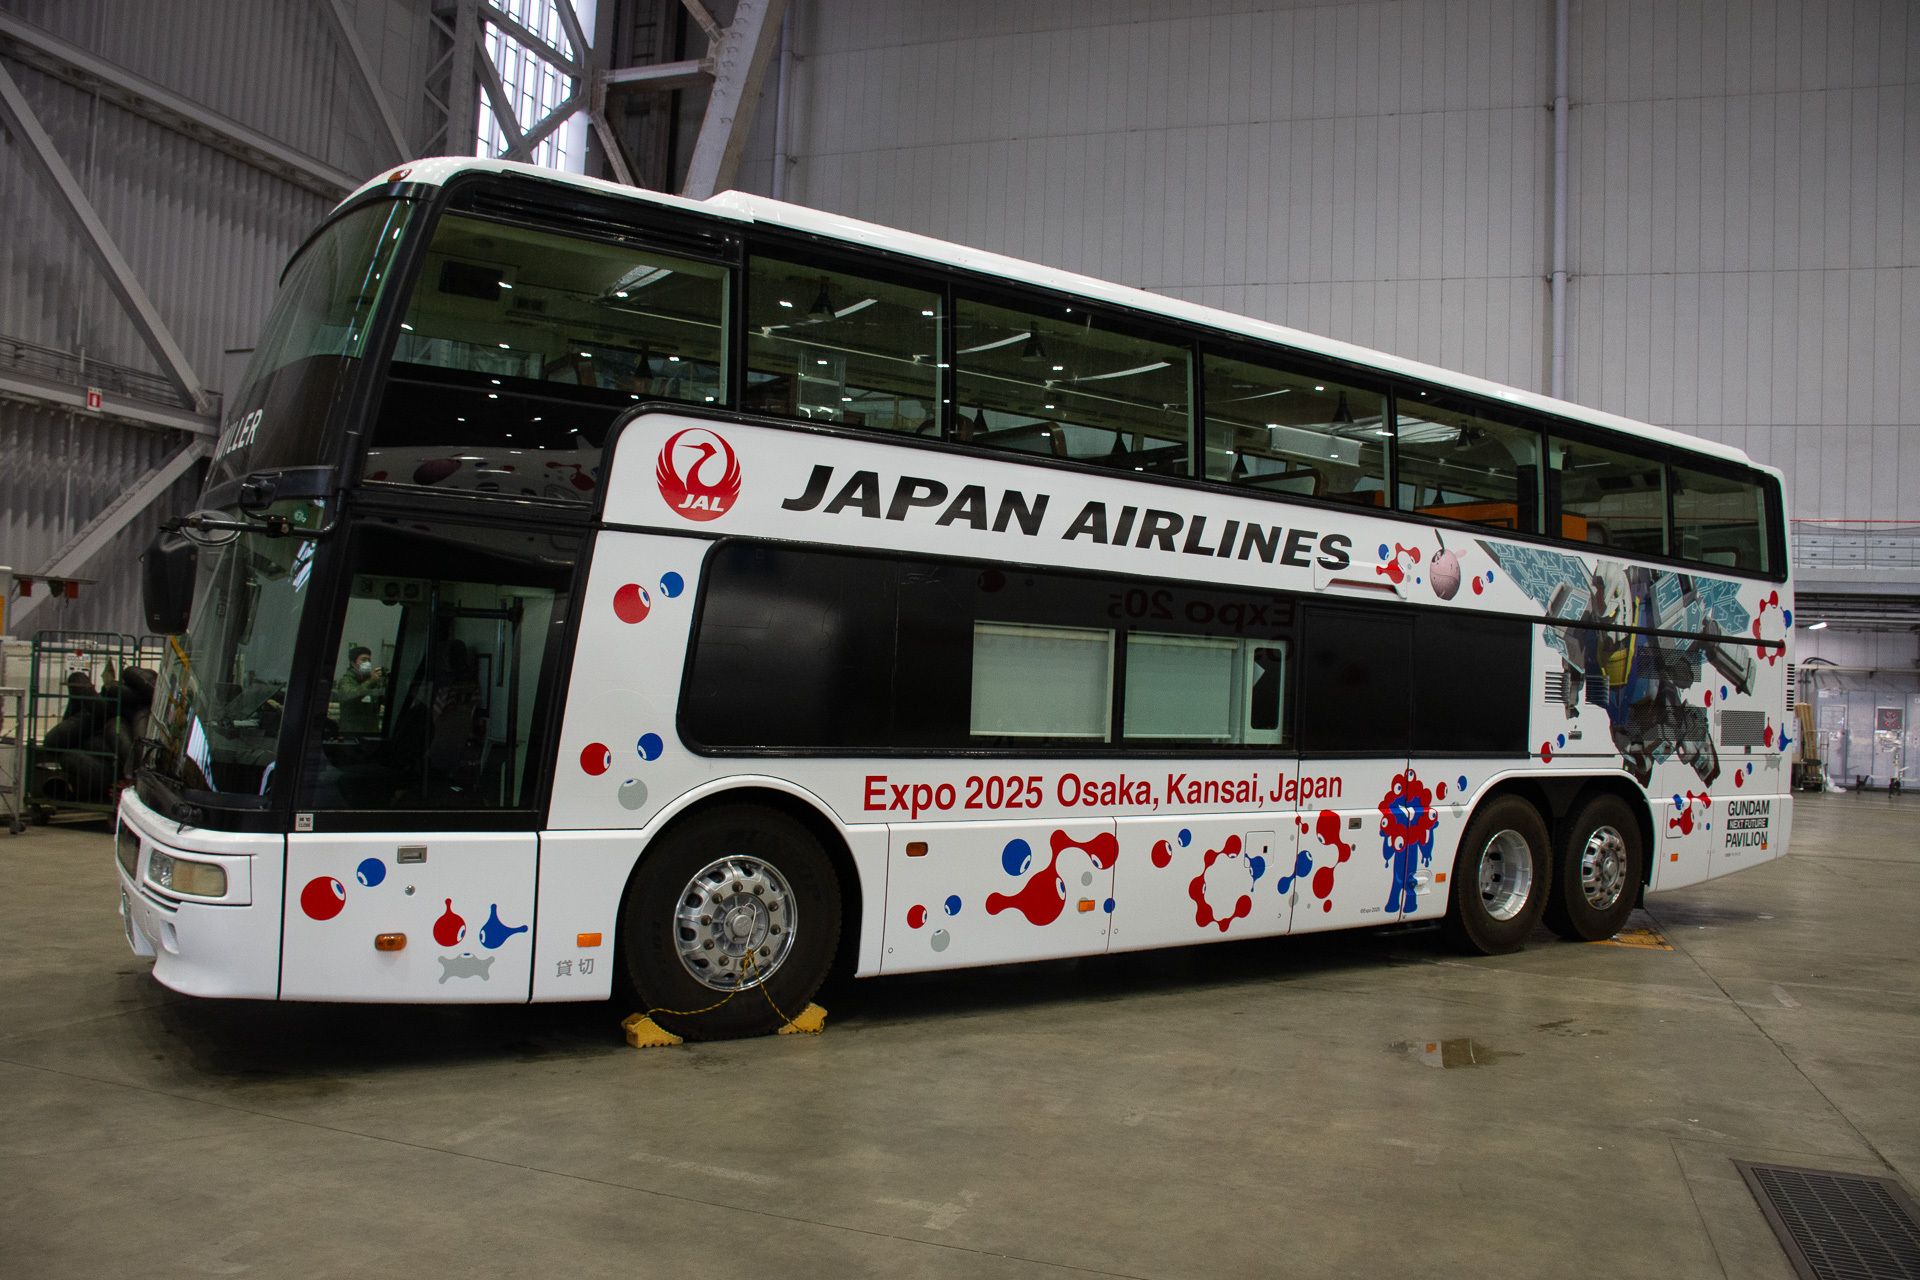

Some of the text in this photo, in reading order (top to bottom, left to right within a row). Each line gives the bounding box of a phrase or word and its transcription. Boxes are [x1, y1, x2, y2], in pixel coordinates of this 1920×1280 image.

[677, 493, 724, 512] JAL
[781, 465, 1352, 571] JAPAN AIRLINES
[864, 772, 1342, 821] Expo 2025 Osaka, Kansai, Japan
[1727, 800, 1770, 816] GUNDAM
[1730, 819, 1766, 828] NEXT FUTURE
[1725, 831, 1768, 848] PAVILION
[556, 958, 594, 977] 貸切
